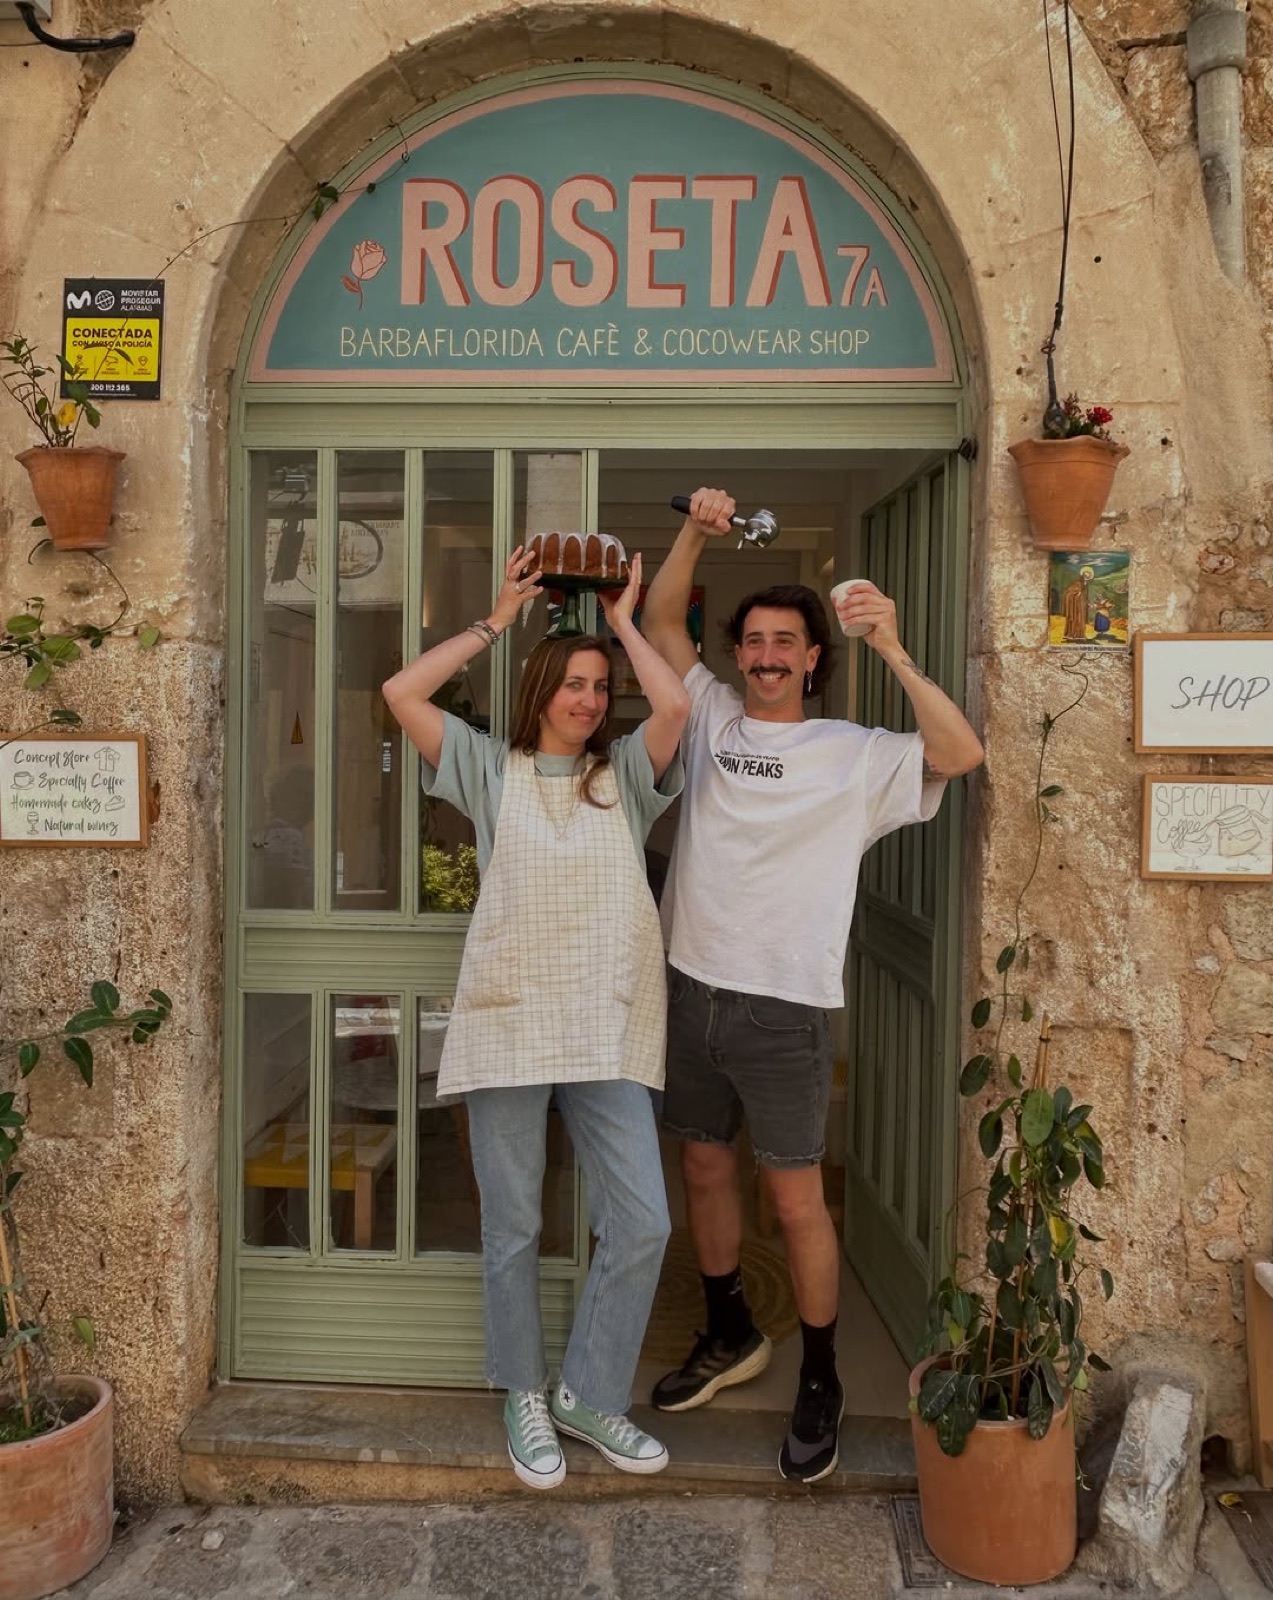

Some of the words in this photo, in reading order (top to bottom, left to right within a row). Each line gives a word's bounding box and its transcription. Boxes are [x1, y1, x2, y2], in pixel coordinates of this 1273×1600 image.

[401, 175, 832, 309] ROSETA
[72, 328, 153, 339] CONECTADA
[340, 327, 544, 358] BARBAFLORIDA
[633, 328, 653, 356] &
[663, 327, 802, 356] COCOWEAR
[810, 329, 871, 356] SHOP
[72, 340, 89, 348] CON
[1171, 674, 1271, 712] SHOP
[14, 749, 60, 768] Concept
[741, 759, 784, 779] PEAKS
[91, 772, 125, 794] Coffee
[11, 794, 67, 812] Homemade
[44, 817, 85, 837] Natural
